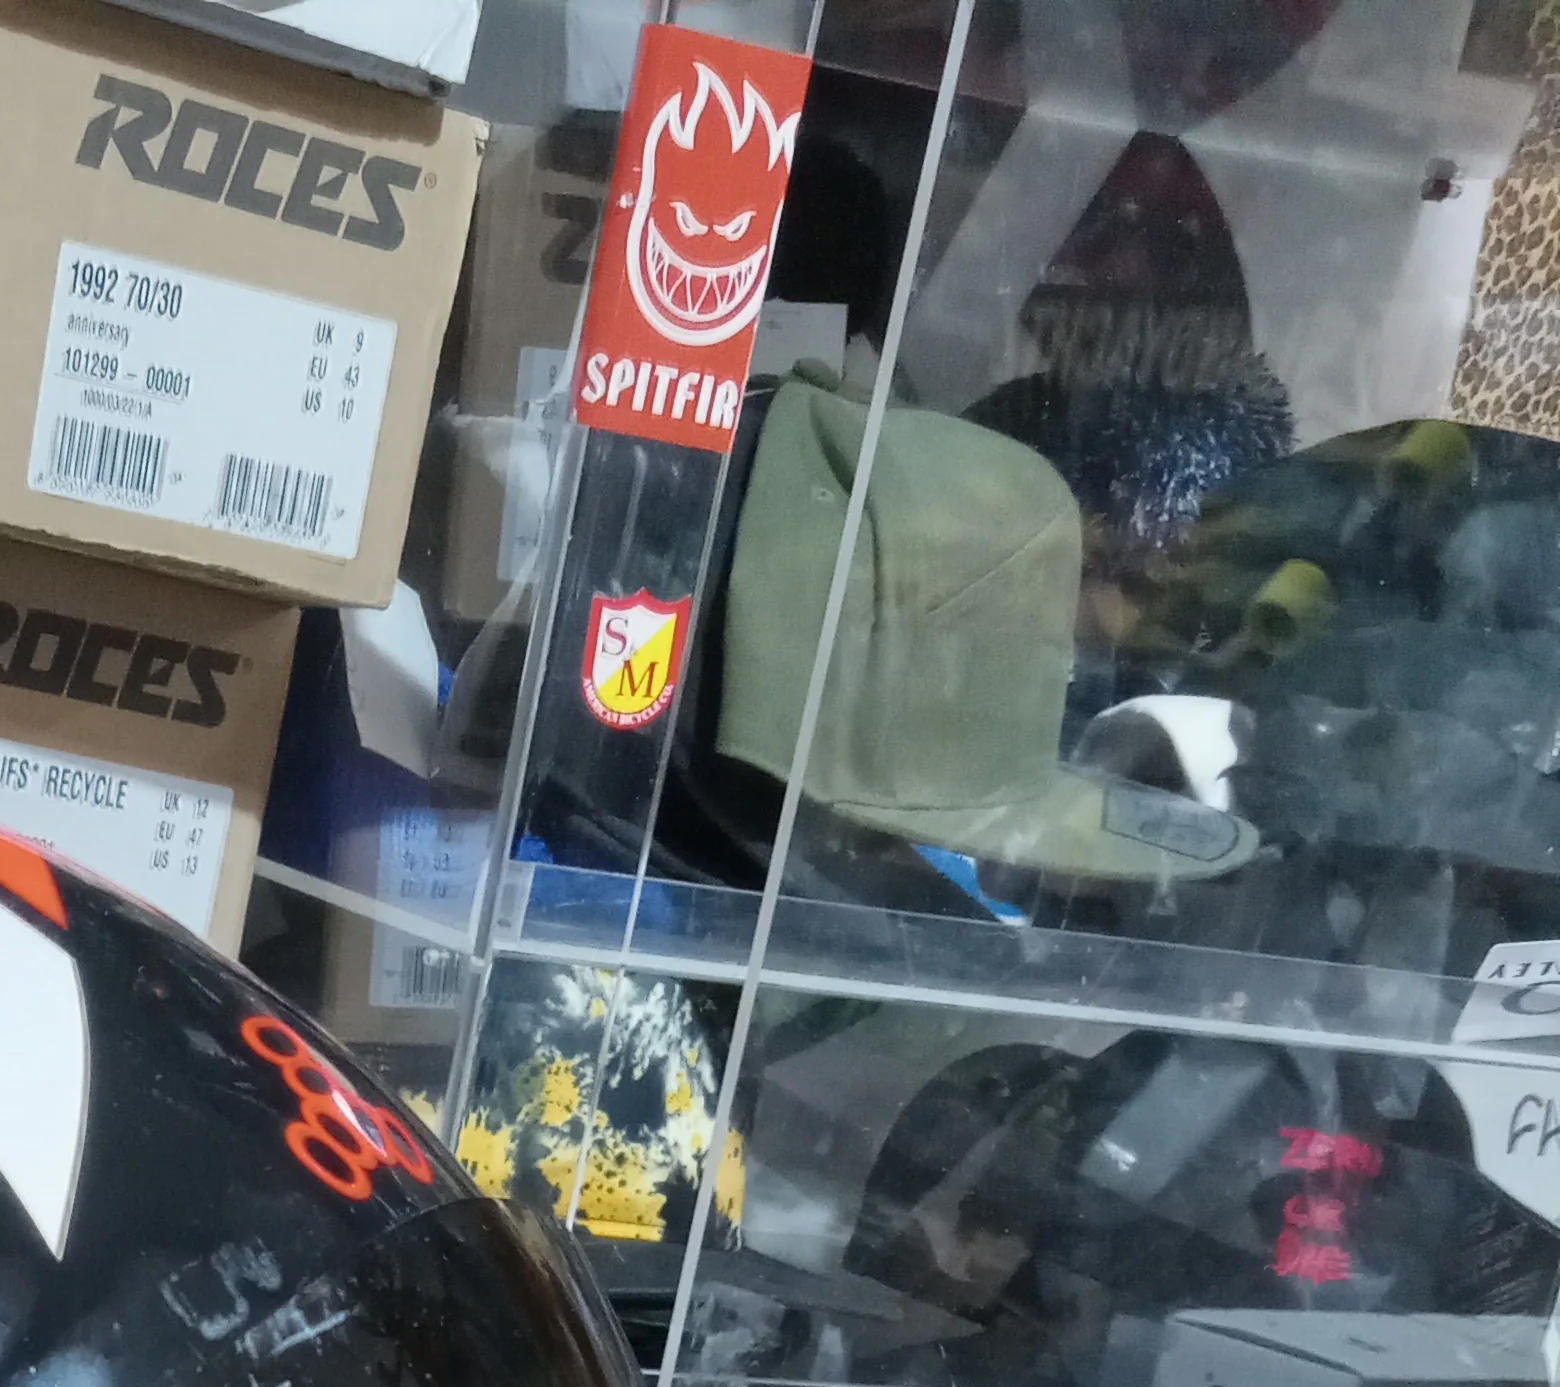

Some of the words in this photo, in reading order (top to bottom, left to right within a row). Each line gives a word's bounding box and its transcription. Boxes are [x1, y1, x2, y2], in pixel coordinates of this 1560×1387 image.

[75, 74, 422, 251] ROCES
[69, 259, 118, 303] 1992
[127, 274, 183, 320] 70/30
[314, 321, 334, 345] UK
[355, 332, 365, 353] 9
[64, 347, 118, 381] 101299
[146, 366, 190, 397] 00001
[310, 357, 328, 380] EU
[344, 366, 359, 388] 43
[303, 389, 322, 412] US
[340, 399, 354, 420] 10
[601, 616, 628, 656] S
[615, 660, 659, 698] M
[41, 765, 128, 809] RECYCLE
[161, 791, 180, 813] UK
[193, 799, 209, 820] 12
[156, 821, 175, 843] EU
[186, 828, 203, 848] 47
[151, 850, 170, 871] US
[182, 857, 198, 876] 13
[1488, 961, 1560, 980] LEY
